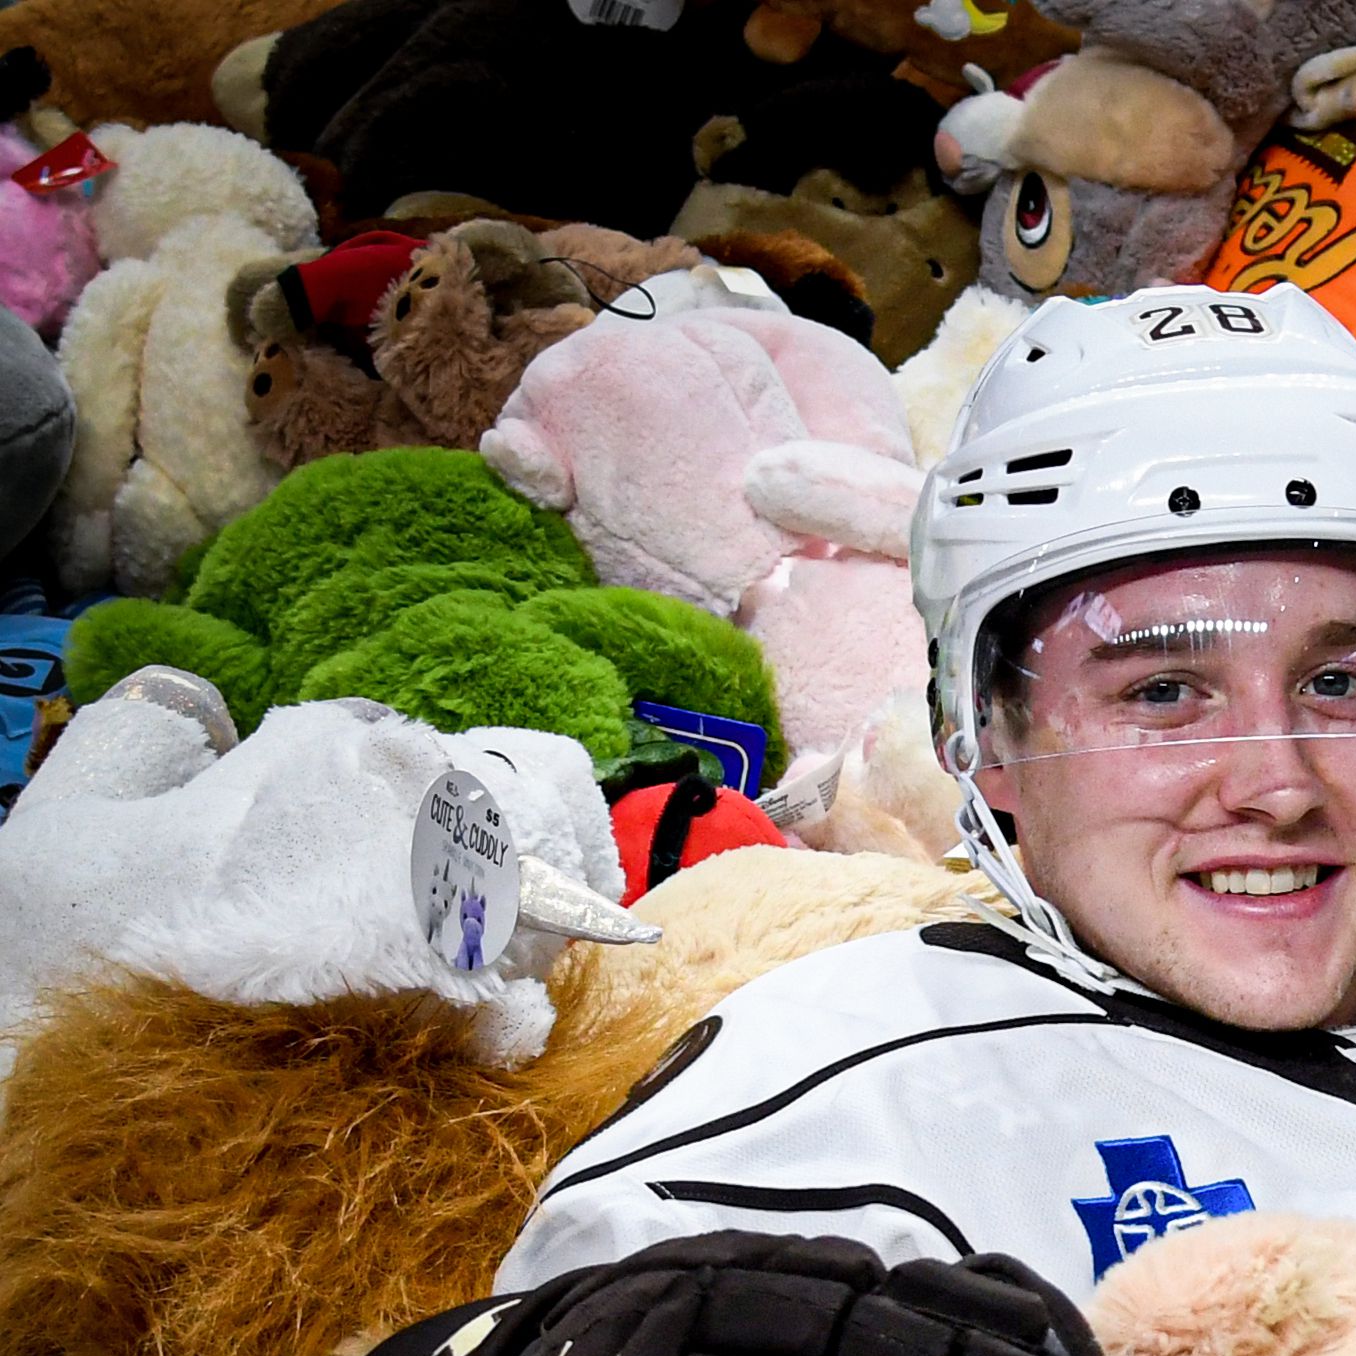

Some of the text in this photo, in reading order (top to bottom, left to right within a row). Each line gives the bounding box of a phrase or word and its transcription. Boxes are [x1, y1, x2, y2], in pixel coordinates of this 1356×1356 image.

[1139, 304, 1265, 341] 28
[430, 794, 455, 833] CUTE
[453, 805, 468, 850] &
[469, 823, 509, 868] CUDDLY
[486, 808, 500, 827] $5
